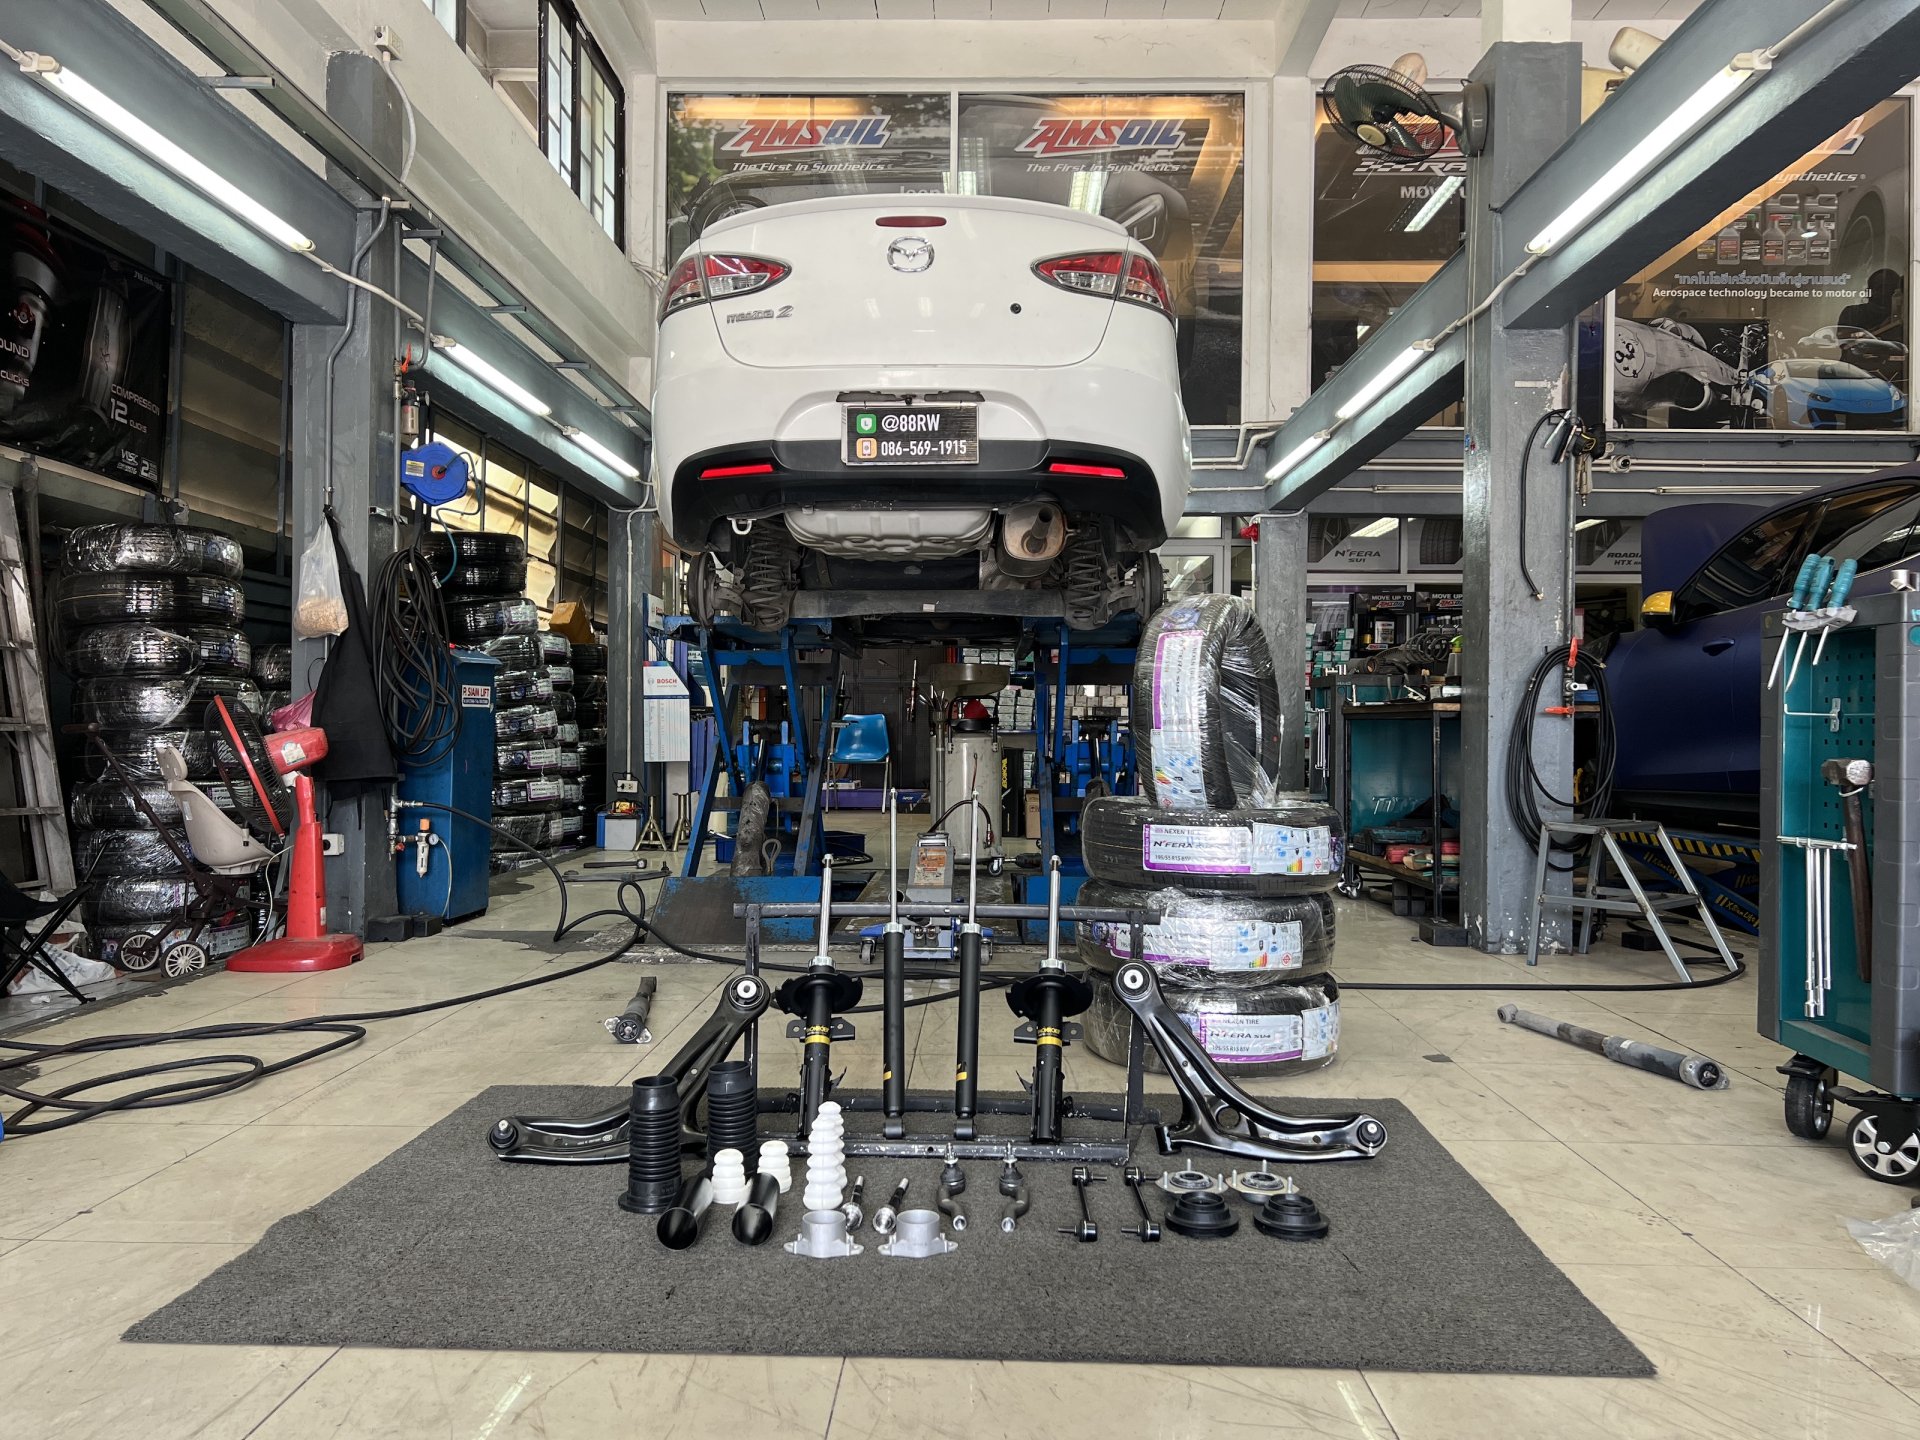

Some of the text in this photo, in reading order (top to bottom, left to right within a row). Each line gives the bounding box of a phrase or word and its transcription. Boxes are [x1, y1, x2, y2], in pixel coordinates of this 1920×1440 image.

[722, 116, 890, 156] AMSOIL
[1016, 117, 1186, 157] AMSOIL
[733, 162, 885, 173] The First In Synthetics
[1025, 162, 1180, 173] The First In Synthetics
[1773, 171, 1858, 183] ynthetics
[1653, 288, 1872, 299] Aerospace technology became to motor oil
[776, 305, 793, 318] 2
[0, 370, 30, 387] CLICKS
[111, 383, 160, 416] COMPRESSION
[110, 398, 128, 424] 12
[882, 414, 940, 432] @88RW
[881, 440, 967, 456] 086-569-1915
